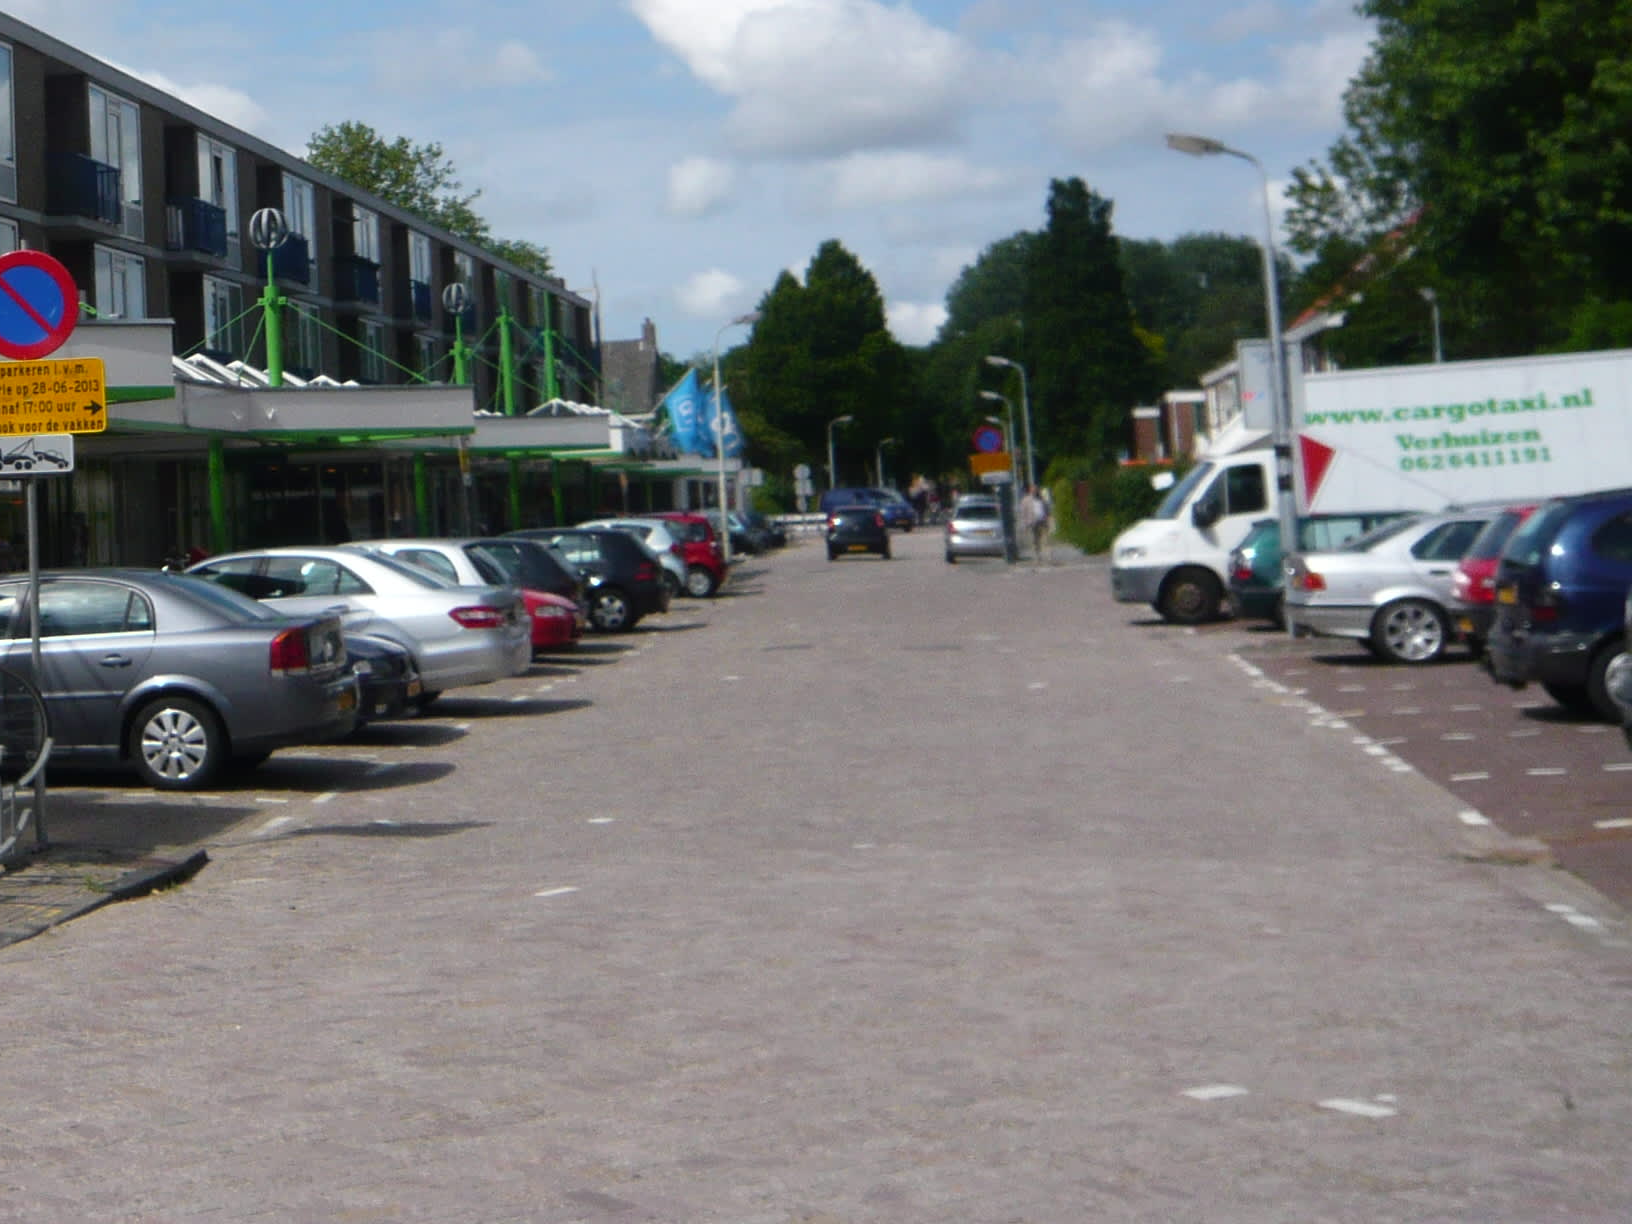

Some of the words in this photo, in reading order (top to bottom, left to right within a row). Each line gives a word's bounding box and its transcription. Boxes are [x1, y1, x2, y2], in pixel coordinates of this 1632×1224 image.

[0, 365, 49, 378] parkeren
[16, 384, 29, 396] op
[32, 379, 99, 394] 28-06-2013
[23, 399, 53, 414] 17:00
[57, 401, 76, 413] uur
[1303, 387, 1594, 425] www.cargotaxi.nl
[19, 421, 42, 432] voor
[46, 419, 59, 431] de
[62, 418, 103, 431] vakken
[1395, 427, 1541, 451] Verhuizen
[1400, 446, 1552, 472] 0626411191
